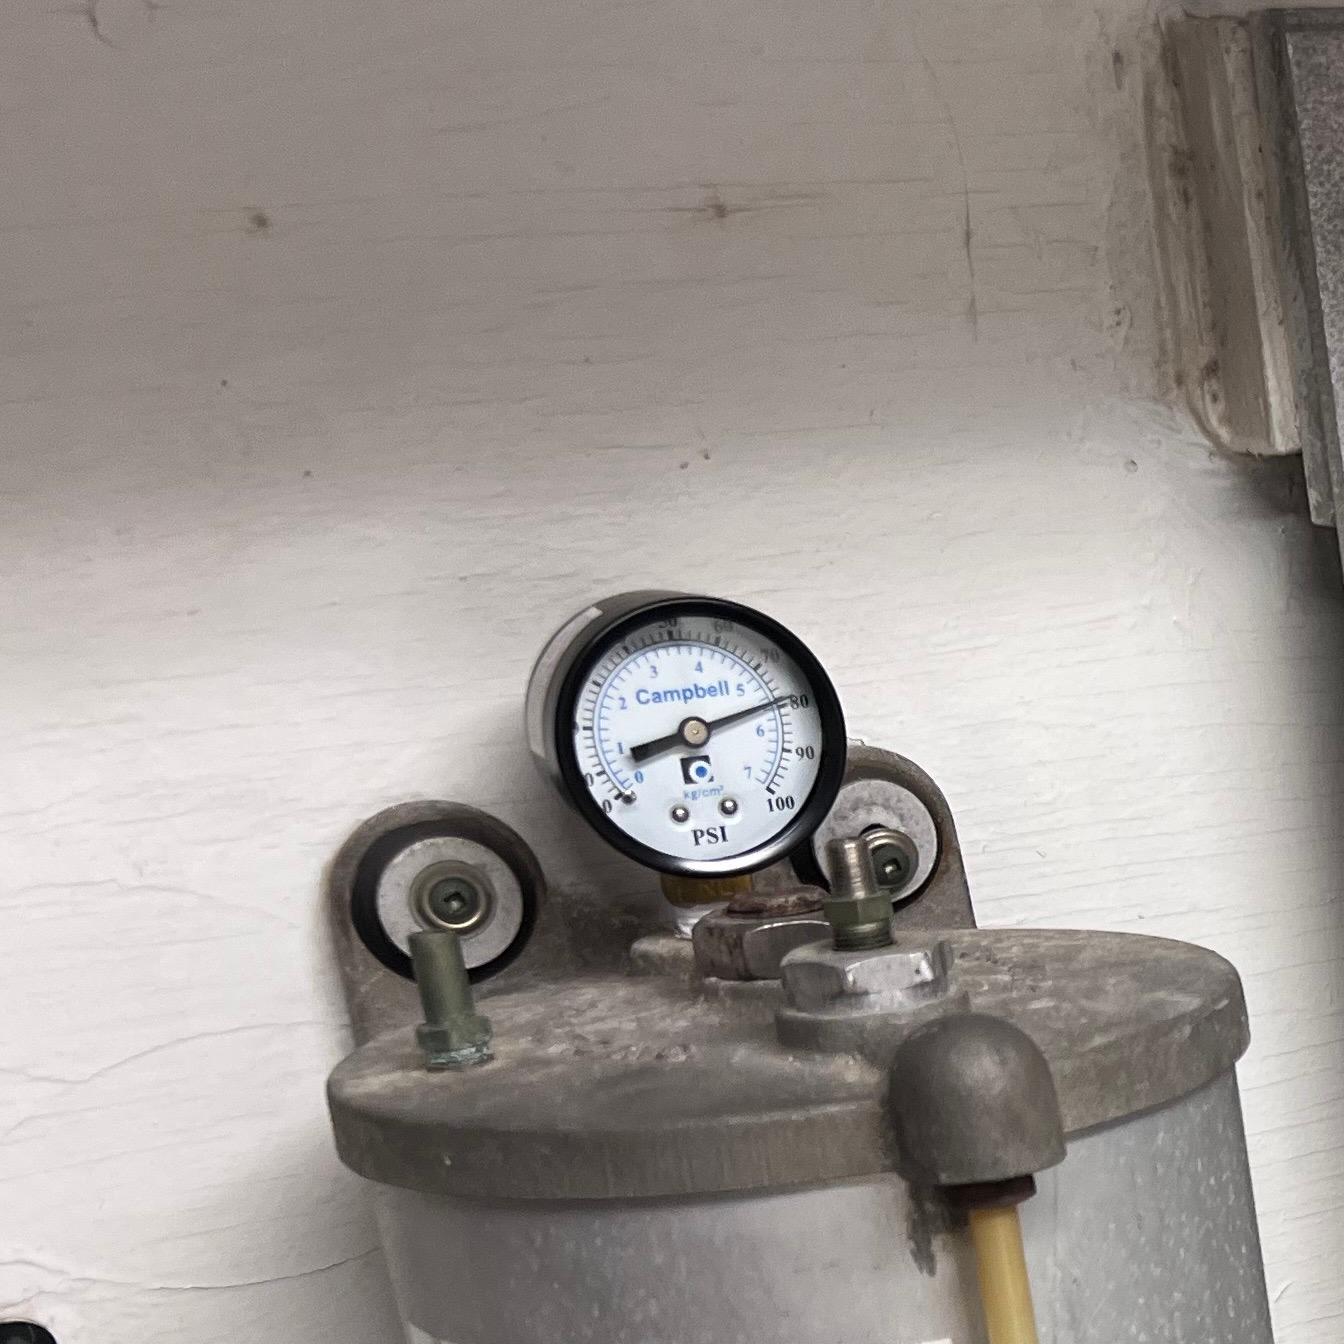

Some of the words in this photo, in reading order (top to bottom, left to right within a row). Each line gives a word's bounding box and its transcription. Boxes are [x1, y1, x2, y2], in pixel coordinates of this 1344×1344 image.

[649, 665, 659, 679] 3
[694, 661, 704, 674] 4
[635, 680, 729, 706] Campbell
[736, 684, 747, 697] 5
[618, 697, 628, 710] 2
[755, 724, 766, 737] 6
[795, 744, 816, 760] 90
[633, 770, 644, 785] 0
[744, 766, 754, 779] 7
[767, 794, 796, 813] 100
[690, 824, 729, 847] PSI
